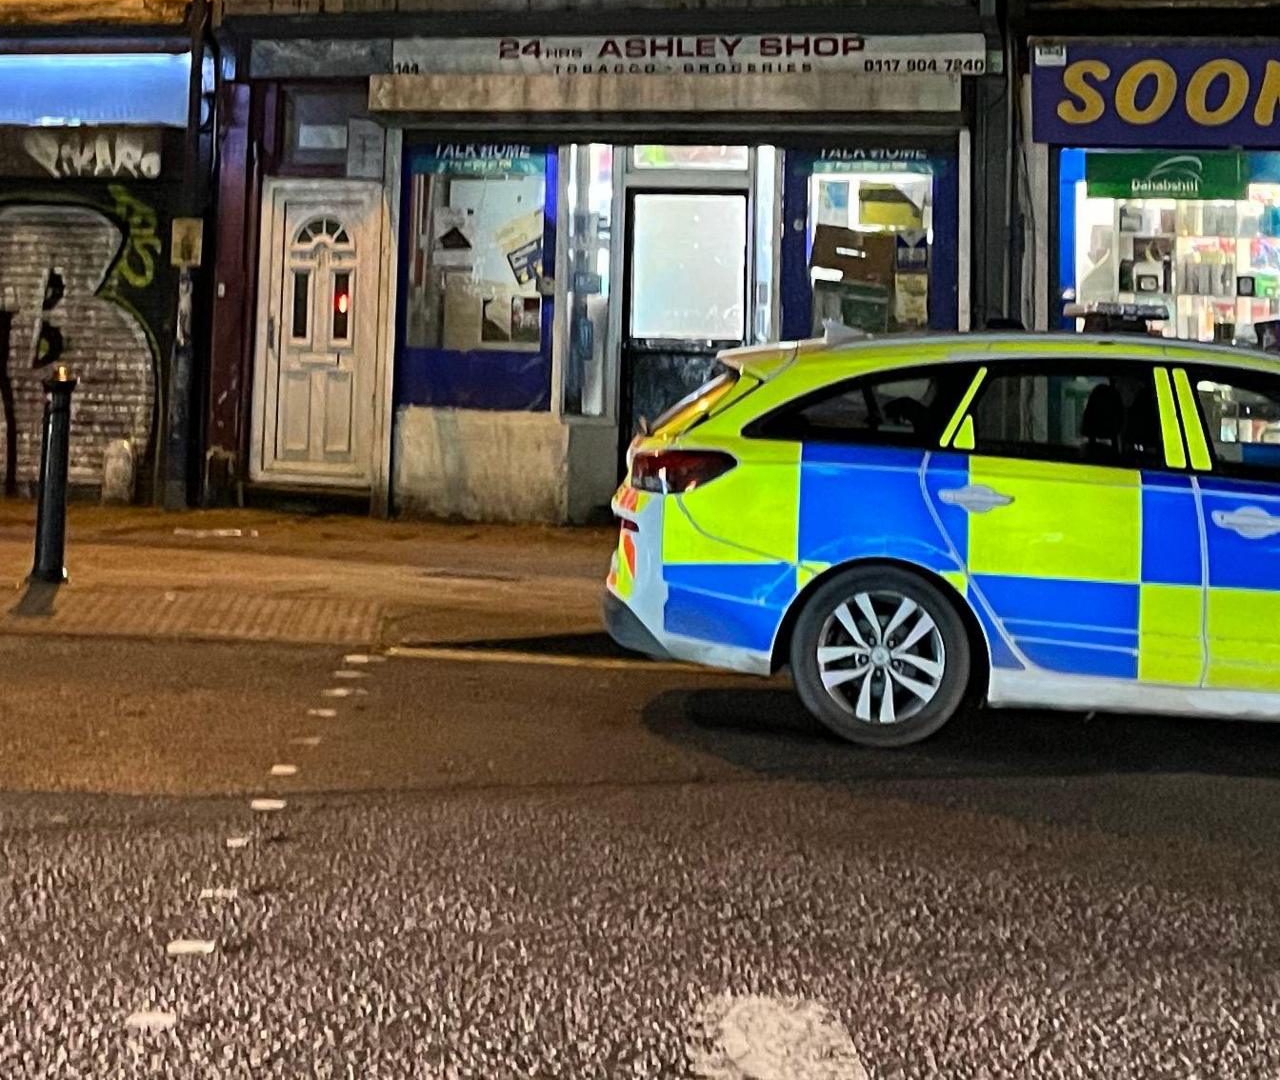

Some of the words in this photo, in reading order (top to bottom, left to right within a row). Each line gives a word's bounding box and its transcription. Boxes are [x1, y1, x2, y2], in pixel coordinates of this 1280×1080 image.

[598, 37, 742, 58] ASHLEY
[759, 36, 865, 57] SHOP
[554, 63, 656, 75] TOBACCO
[683, 63, 813, 74] GROCERIES
[864, 59, 900, 73] 0117
